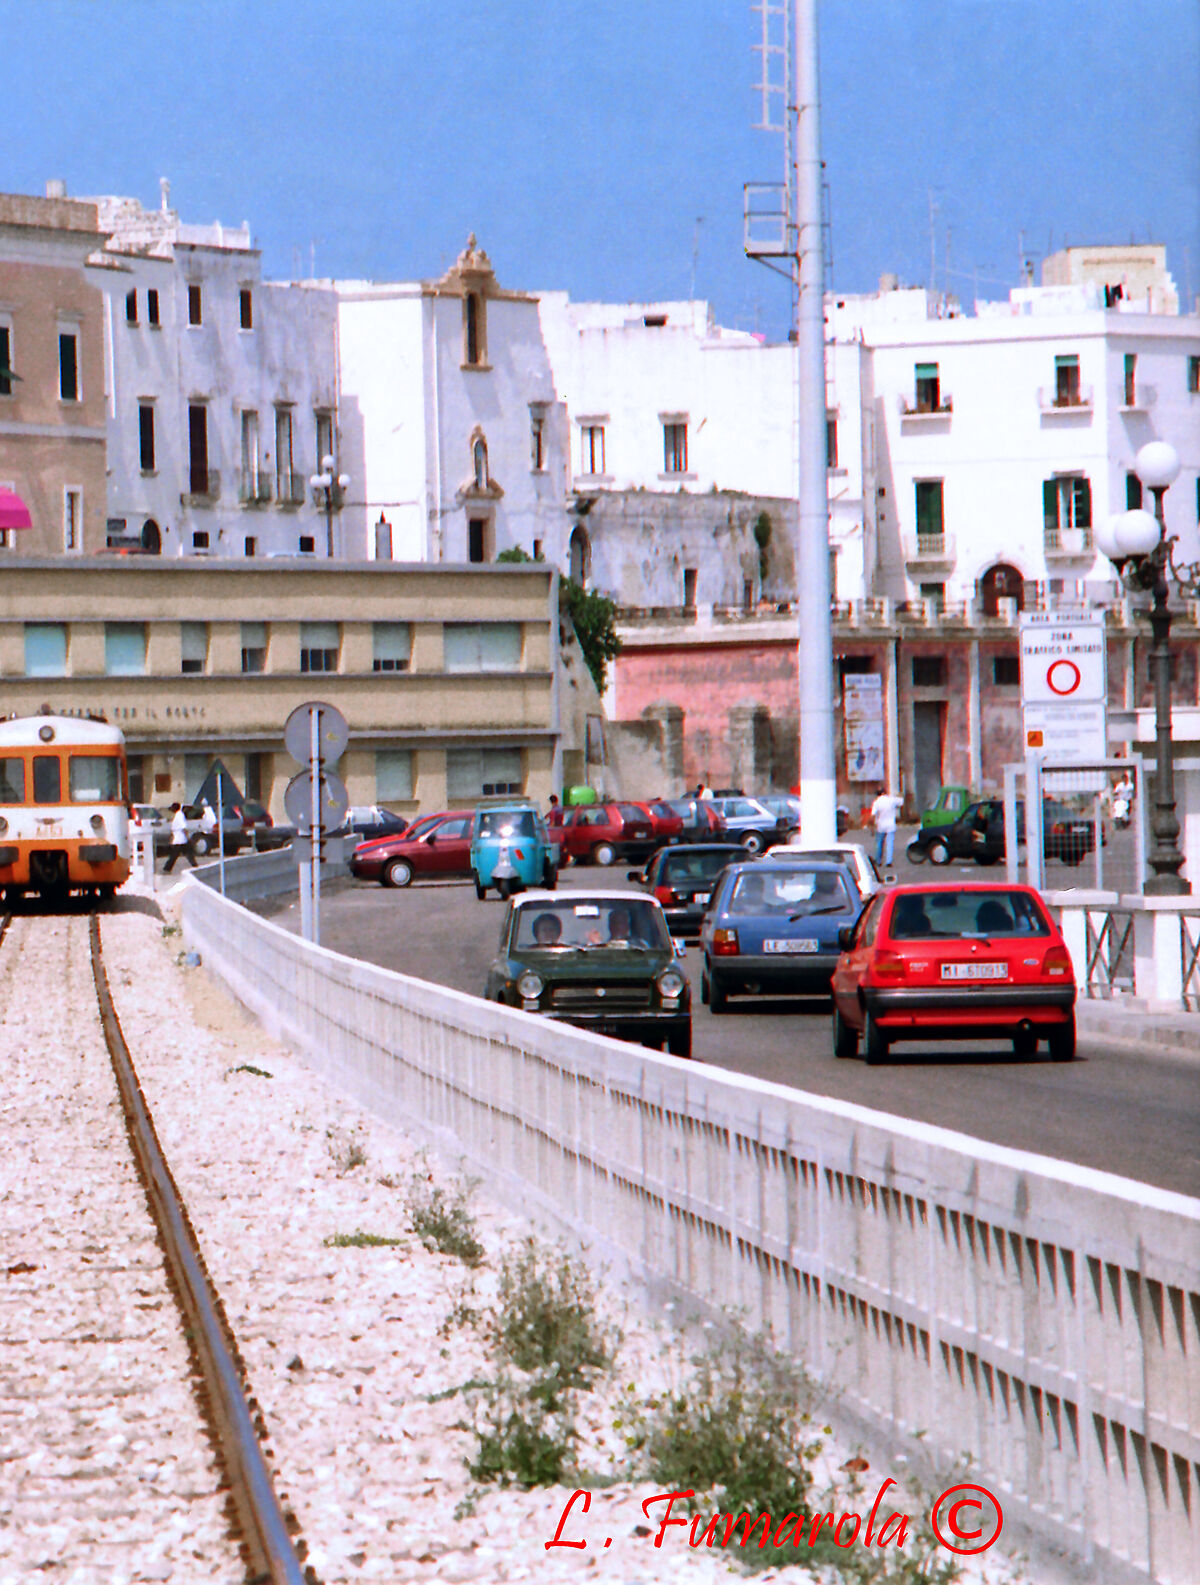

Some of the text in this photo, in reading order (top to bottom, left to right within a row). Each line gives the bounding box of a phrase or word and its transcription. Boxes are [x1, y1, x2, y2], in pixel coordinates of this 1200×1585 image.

[1051, 632, 1073, 641] ZONA
[1023, 644, 1102, 655] TRAFFICO LIMITATO
